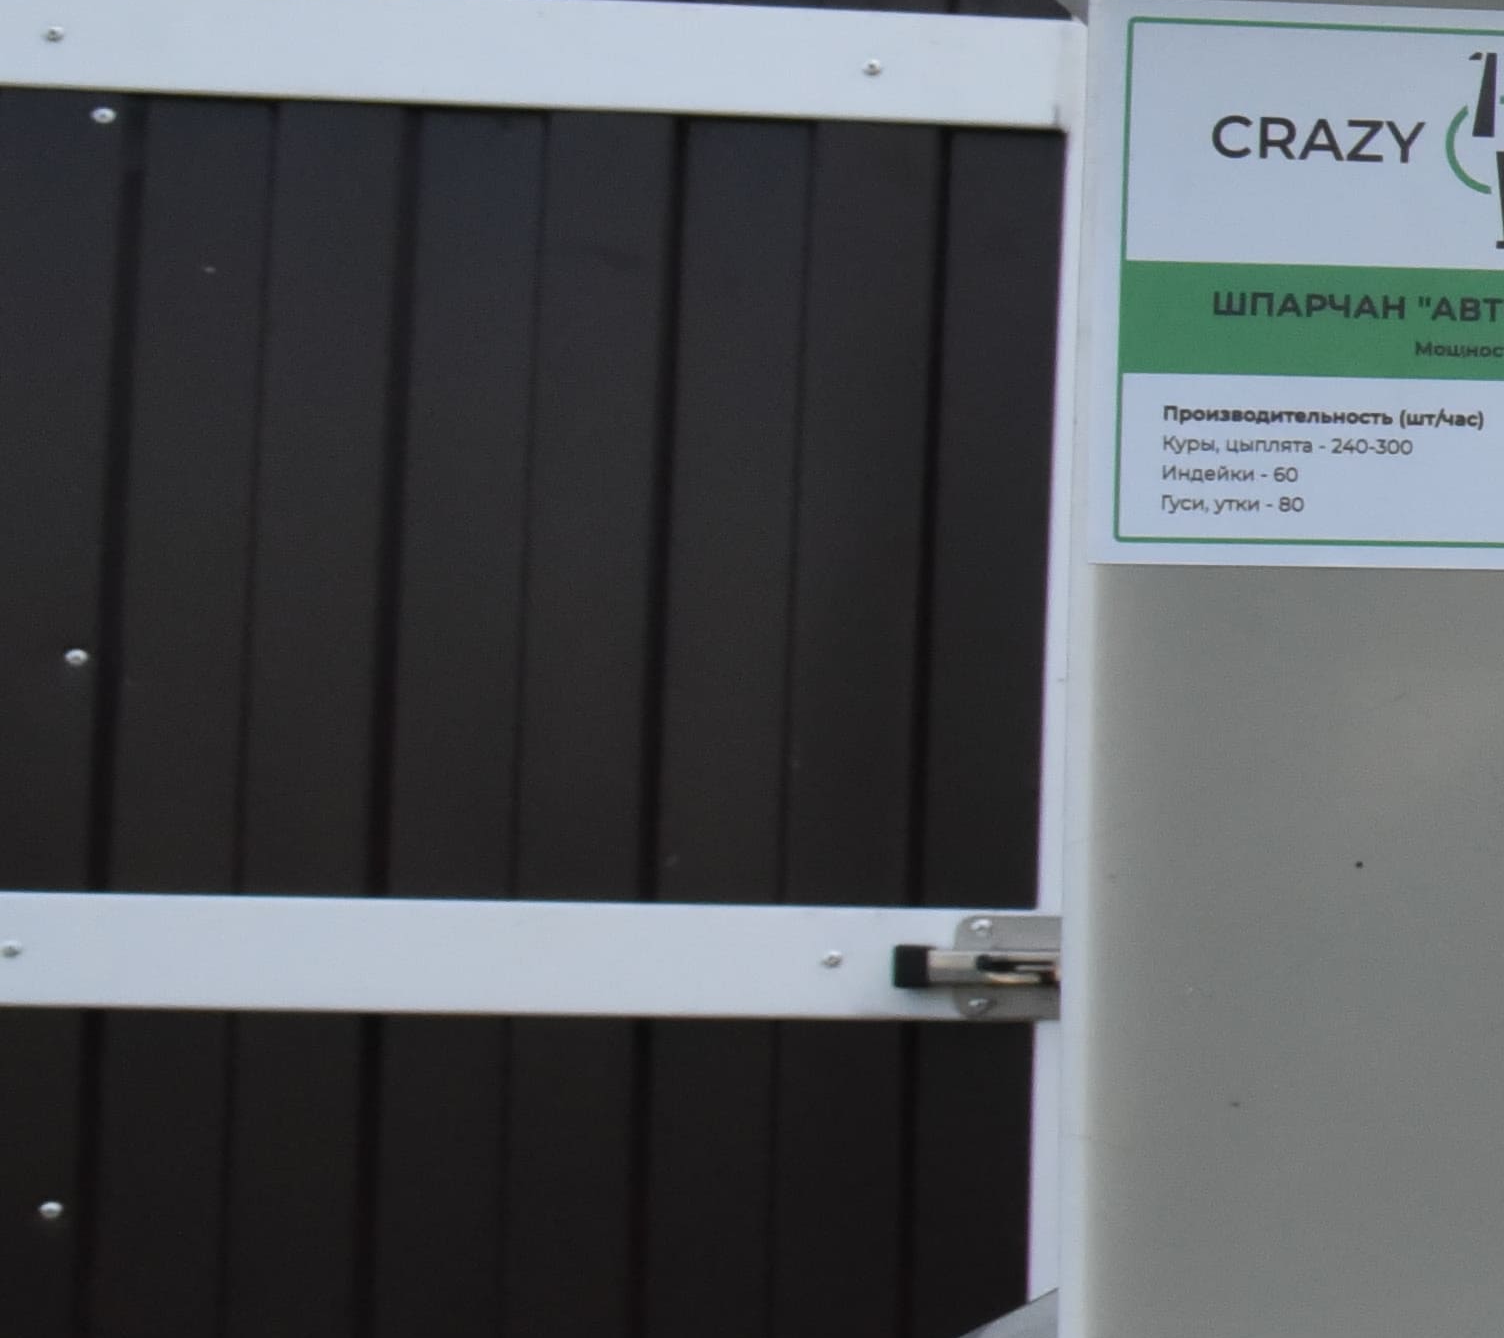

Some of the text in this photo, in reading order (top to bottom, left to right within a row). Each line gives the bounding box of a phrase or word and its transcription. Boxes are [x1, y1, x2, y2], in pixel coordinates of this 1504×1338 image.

[1211, 114, 1427, 164] CRAZY
[1212, 291, 1406, 320] ШПАРЧАН
[1162, 405, 1485, 430] Производительность (шт/час)
[1163, 435, 1220, 454] Куры,
[1225, 438, 1314, 454] цыплята
[1331, 438, 1414, 456] 240-300
[1161, 465, 1255, 484] Индейки
[1273, 467, 1299, 483] 60
[1161, 495, 1209, 514] Гуси,
[1213, 497, 1260, 515] утки
[1278, 496, 1305, 513] 80
